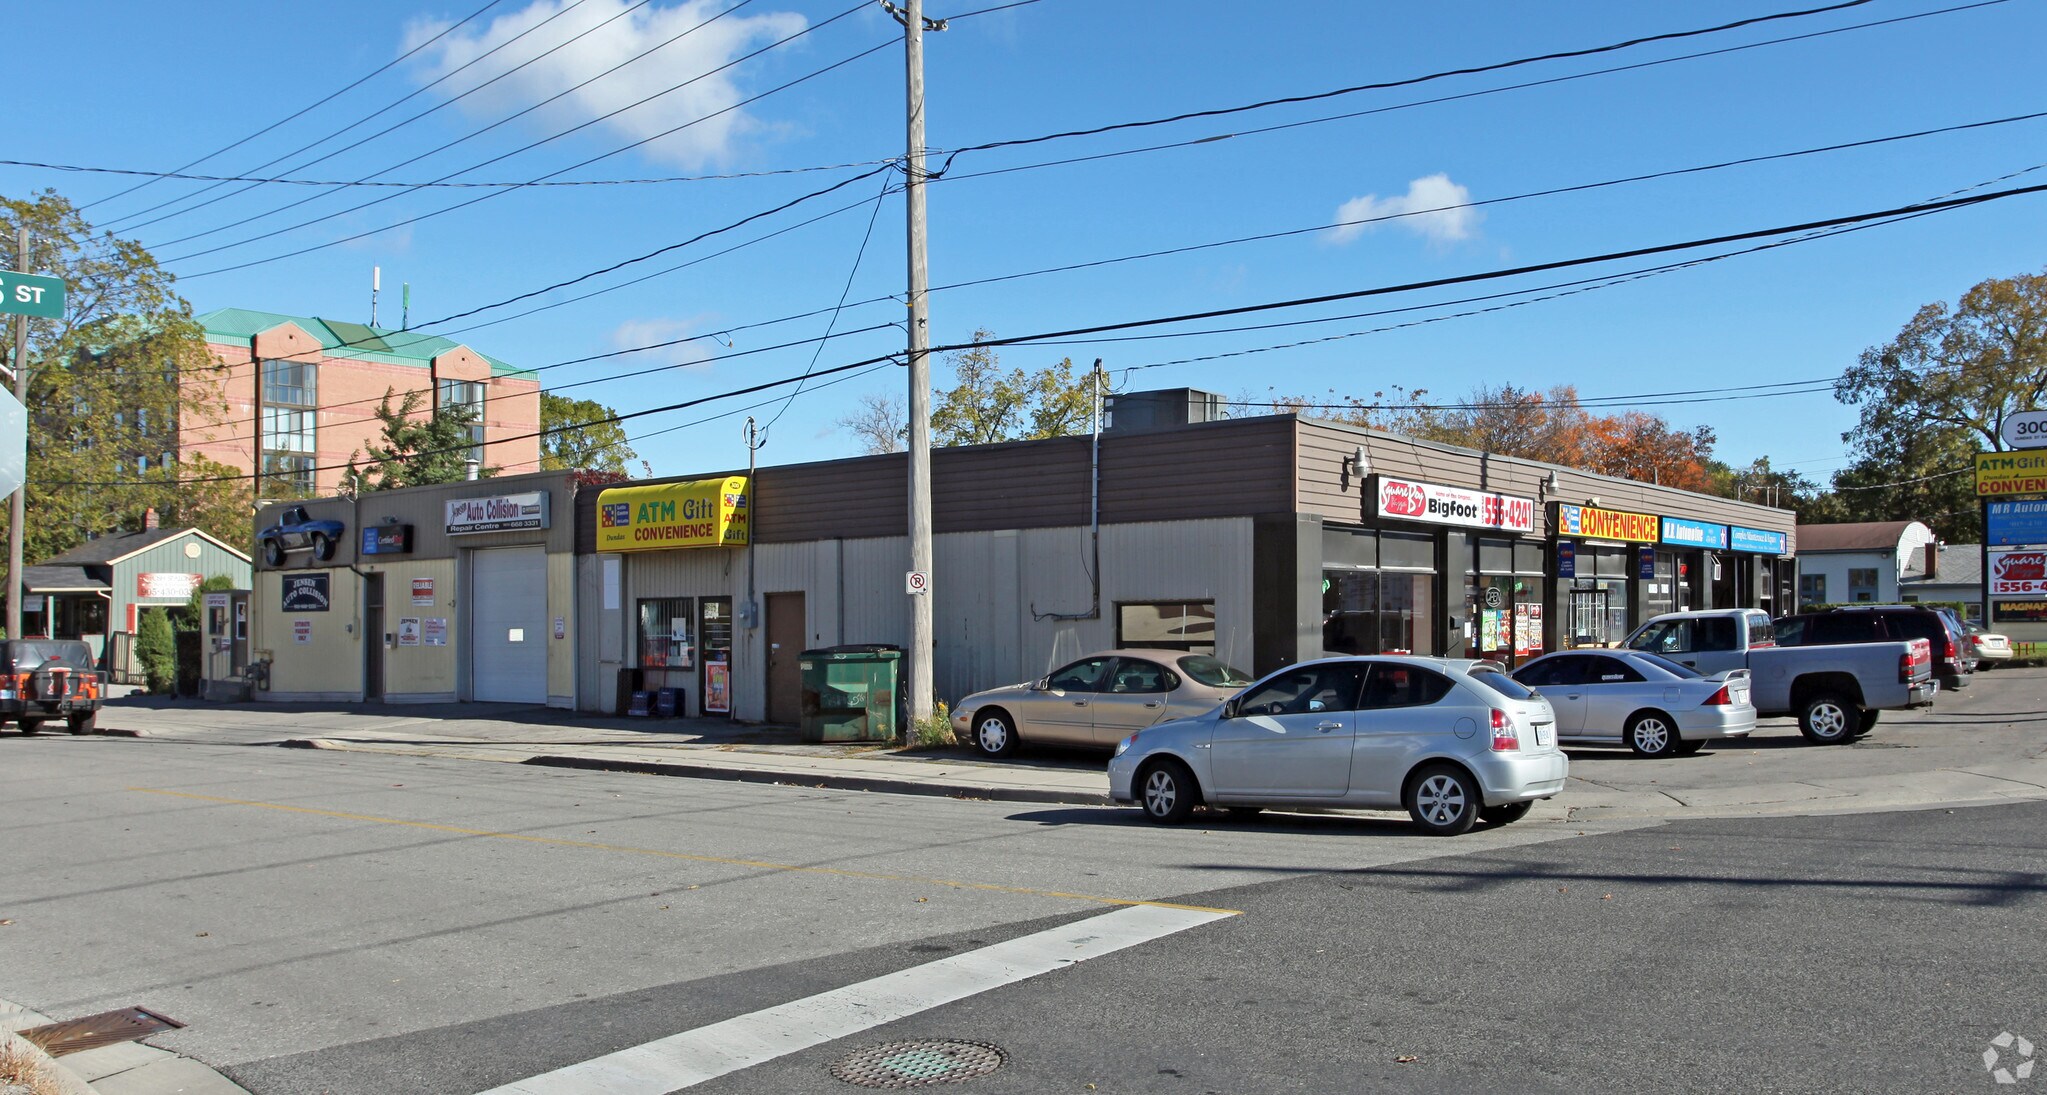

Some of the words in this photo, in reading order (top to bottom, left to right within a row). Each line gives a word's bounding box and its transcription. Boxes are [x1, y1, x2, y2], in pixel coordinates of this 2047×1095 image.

[15, 285, 46, 304] ST
[1979, 458, 2014, 471] ATM
[2017, 457, 2046, 469] Gift
[1978, 478, 2047, 494] CONVEN
[467, 502, 485, 521] Auto
[487, 499, 519, 520] Collision
[637, 500, 675, 524] ATM
[683, 499, 714, 520] Gift
[1428, 498, 1477, 518] Bigfoot
[1485, 496, 1531, 529] 556-4241
[1992, 503, 2010, 514] MR
[724, 513, 746, 524] ATM
[1580, 507, 1656, 541] CONVENIENCE
[450, 525, 475, 533] Repair
[475, 523, 500, 531] Centre
[606, 533, 626, 541] Dundas
[634, 523, 713, 541] CONVENIENCE
[724, 529, 745, 541] Gift
[1994, 553, 2044, 579] Square
[293, 578, 316, 588] JENSEN
[283, 589, 298, 609] AUTO
[298, 587, 329, 607] COLLISION
